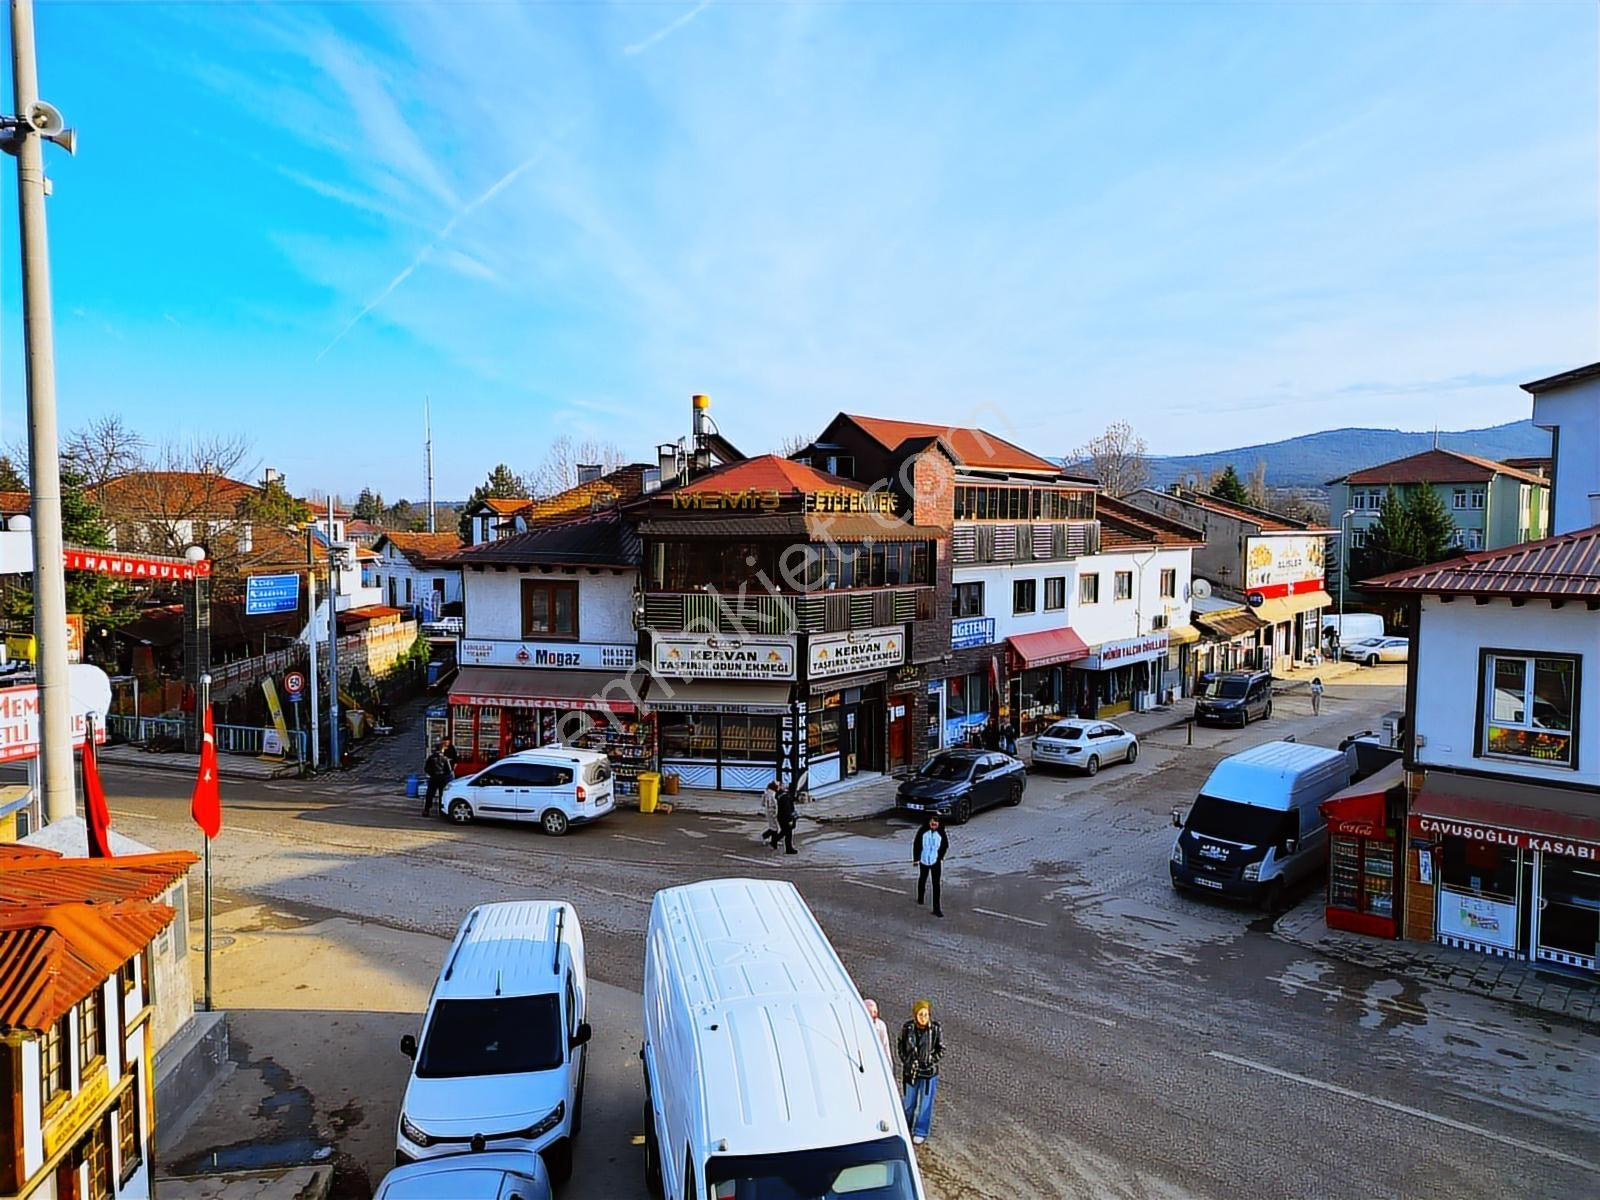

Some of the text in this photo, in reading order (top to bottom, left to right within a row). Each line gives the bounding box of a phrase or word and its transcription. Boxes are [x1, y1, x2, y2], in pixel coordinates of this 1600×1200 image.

[535, 649, 580, 667] Mogaz
[691, 650, 757, 661] KERVAN
[835, 642, 881, 657] KERVAN
[798, 701, 807, 769] EKMEK
[1420, 819, 1596, 860] ÇAVUŞOĞLU KASABI
